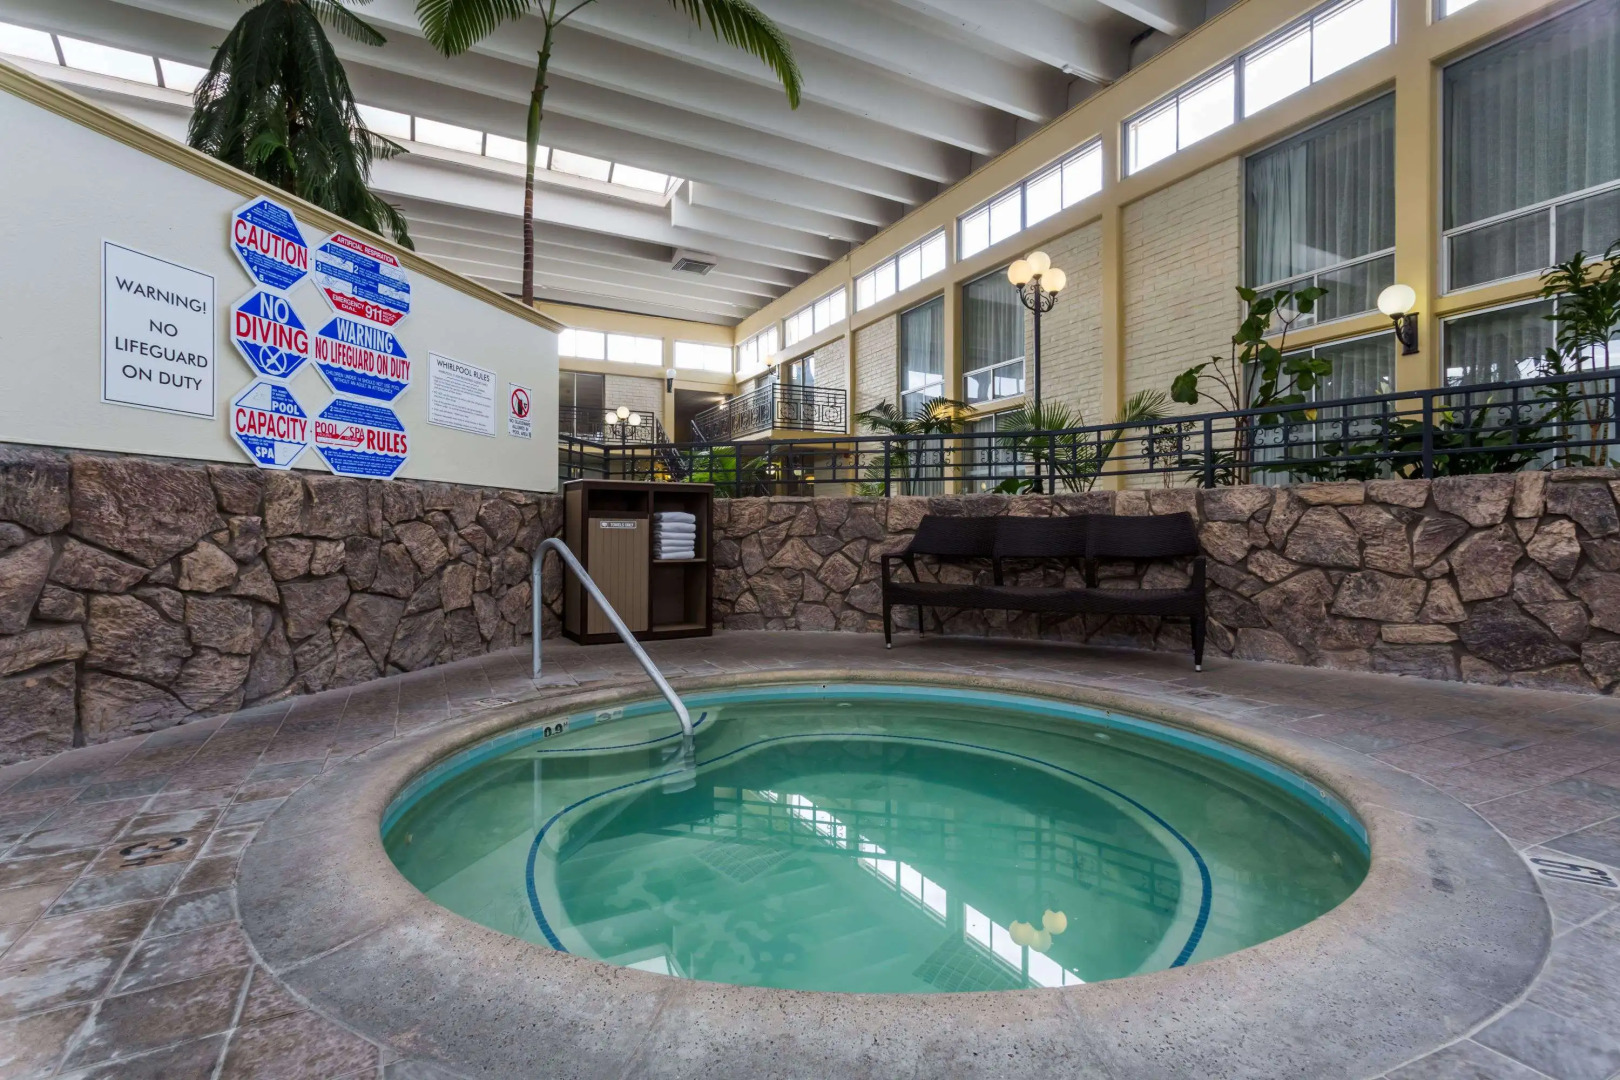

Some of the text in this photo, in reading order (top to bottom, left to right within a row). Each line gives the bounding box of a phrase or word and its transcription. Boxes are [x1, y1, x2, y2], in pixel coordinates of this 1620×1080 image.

[246, 212, 252, 220] 2
[235, 219, 308, 270] CAUTION
[326, 244, 330, 252] 1
[337, 236, 364, 252] ARTIFICIAL
[364, 246, 394, 264] RESPIRATION
[316, 262, 322, 271] 3
[354, 266, 358, 274] 2
[116, 276, 206, 314] WARNING!
[353, 286, 358, 294] 4
[260, 292, 290, 324] NO
[332, 294, 364, 310] EMERGENCY
[342, 304, 357, 312] DIAL
[365, 306, 382, 322] 911
[150, 319, 178, 337] NO
[236, 311, 308, 354] DIVING
[336, 317, 394, 354] WARNING
[116, 336, 208, 368] LIFEGUARD
[316, 336, 328, 362] NO
[330, 341, 374, 372] LIFEGUARD
[376, 354, 388, 376] ON
[390, 357, 410, 380] DUTY
[122, 364, 202, 390] ON DUTY
[436, 359, 472, 377] WHIRLPOOL
[474, 371, 490, 382] RULES
[272, 400, 300, 415] POOL
[236, 408, 307, 441] CAPACITY
[315, 421, 338, 435] POOL
[350, 426, 364, 439] SPA
[367, 429, 407, 454] RULES
[256, 446, 274, 459] SPA
[544, 724, 563, 737] 0.9
